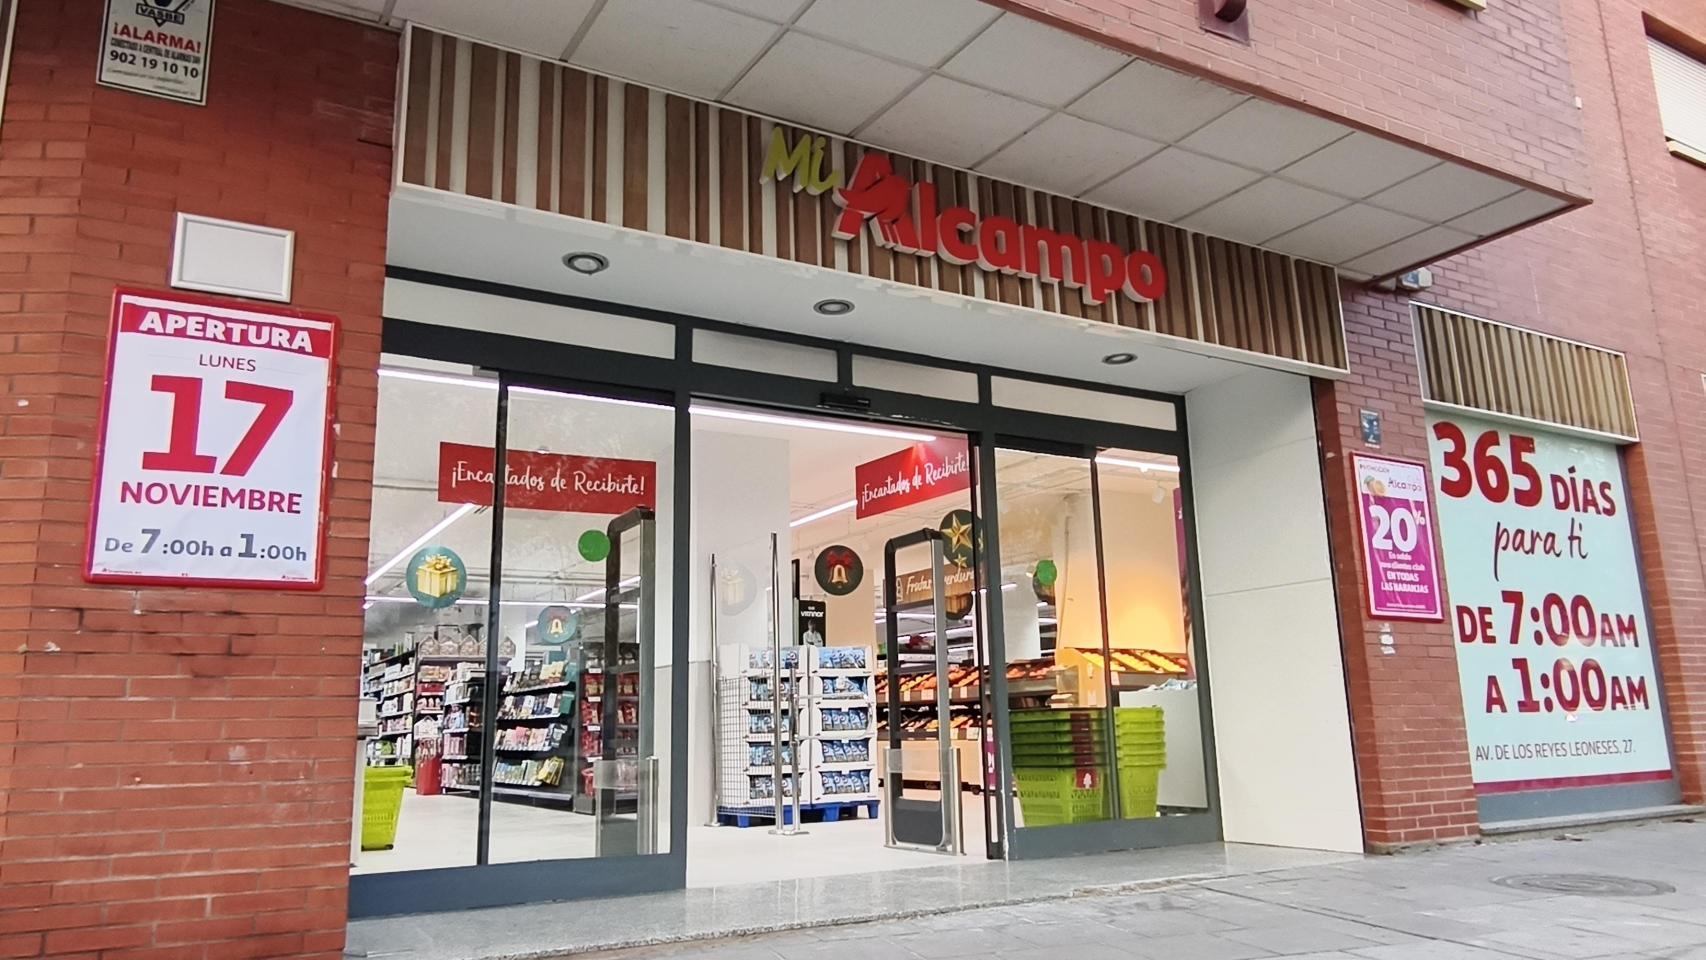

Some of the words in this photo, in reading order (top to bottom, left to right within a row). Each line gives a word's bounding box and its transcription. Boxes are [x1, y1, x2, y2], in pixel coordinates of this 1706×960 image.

[113, 22, 202, 54] ¡ALARMA!
[110, 50, 136, 66] 902
[141, 57, 158, 70] 19
[163, 61, 178, 74] 10
[184, 66, 199, 79] 10
[760, 126, 840, 196] Mi
[832, 152, 1167, 306] Alcampo
[139, 311, 313, 353] APERTURA
[199, 354, 257, 372] LUNES
[142, 374, 294, 477] 17
[452, 461, 545, 491] ¡Encatados
[551, 468, 567, 492] de
[574, 471, 645, 495] Recibirte!
[912, 465, 922, 490] de
[1432, 420, 1543, 508] 365
[1550, 465, 1617, 517] DÍAS
[120, 481, 303, 515] NOVIEMBRE
[104, 537, 133, 553] De
[140, 528, 214, 557] 7:00h
[220, 546, 233, 557] a
[238, 533, 307, 562] 1:00h
[1493, 521, 1562, 582] para
[1568, 517, 1588, 559] ti
[1456, 605, 1497, 644] DE
[1486, 675, 1508, 713] A
[1475, 745, 1494, 761] AV.
[1495, 744, 1510, 760] DE
[1513, 743, 1533, 759] LOS
[1536, 742, 1568, 758] REYES
